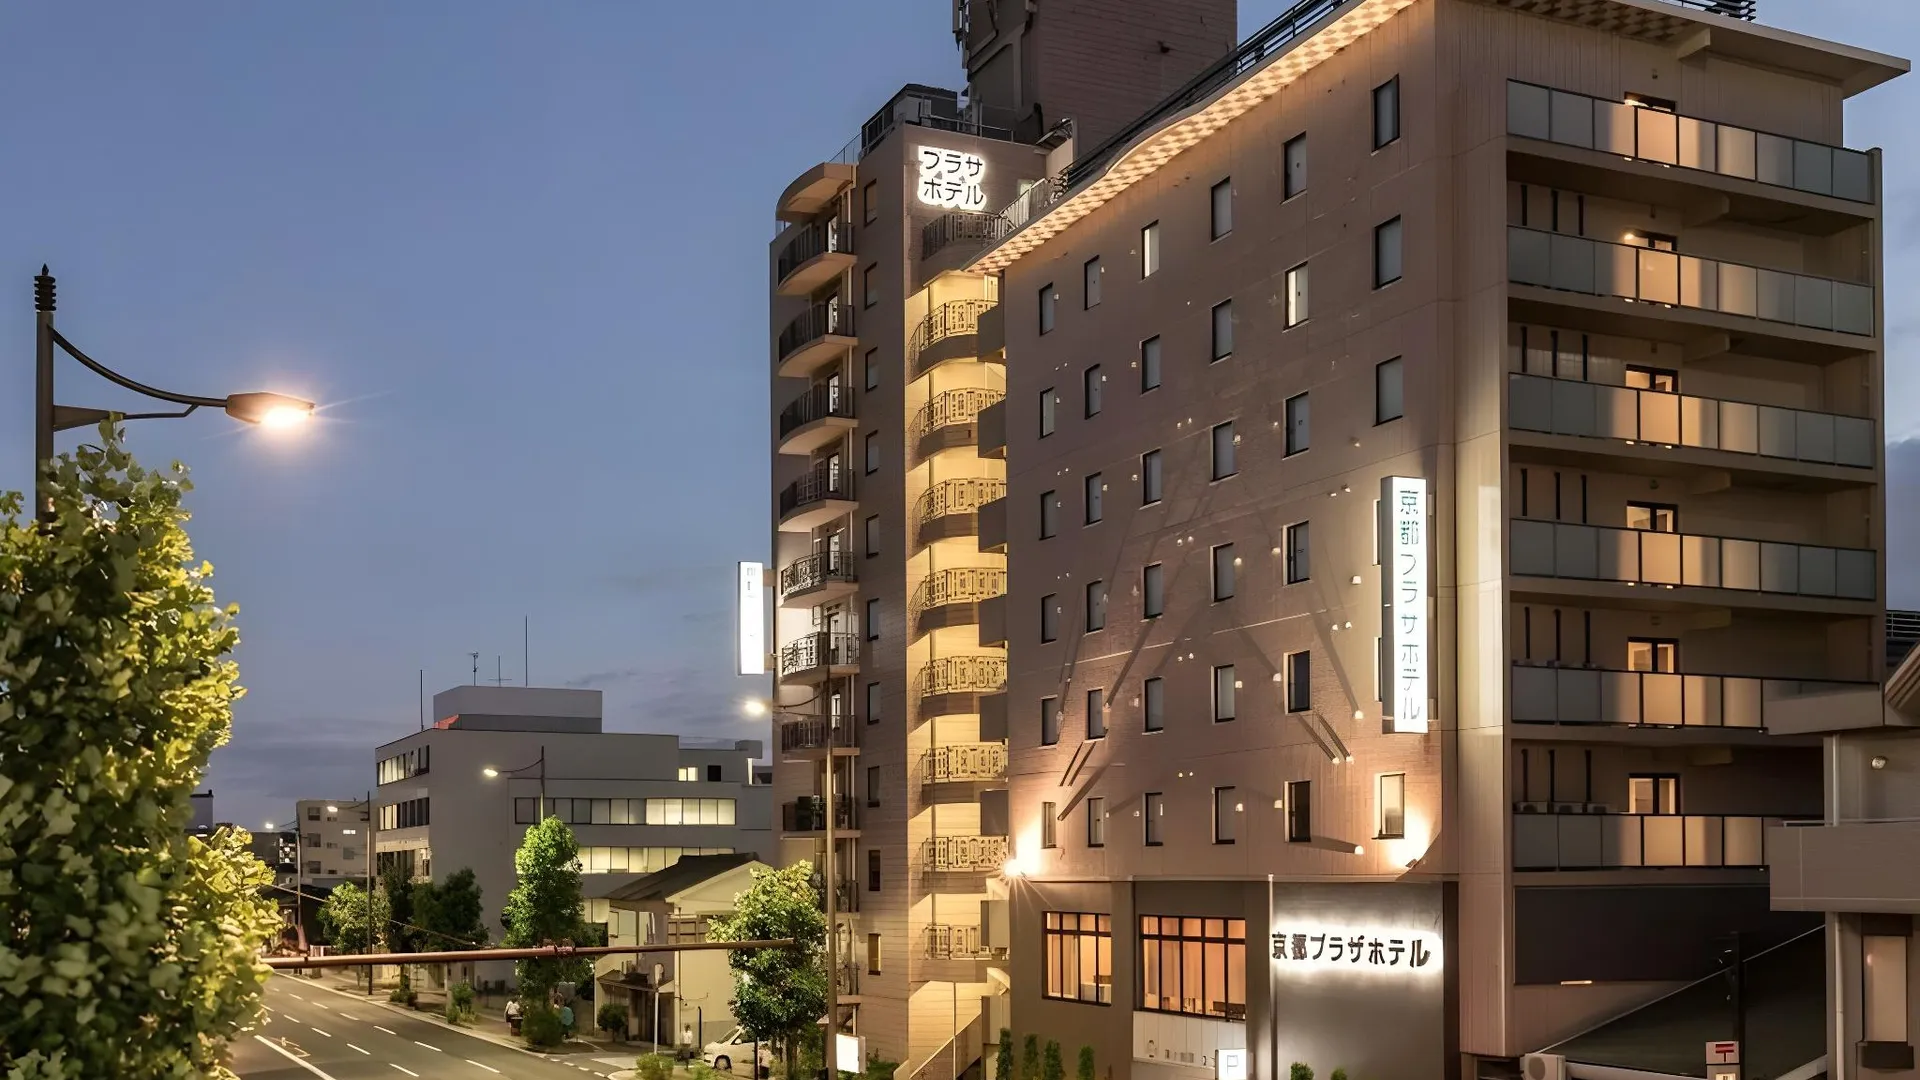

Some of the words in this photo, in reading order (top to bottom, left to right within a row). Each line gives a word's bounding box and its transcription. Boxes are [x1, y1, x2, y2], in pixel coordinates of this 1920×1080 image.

[923, 178, 984, 205] ホテル
[1271, 931, 1431, 968] 京都プラザホテル
